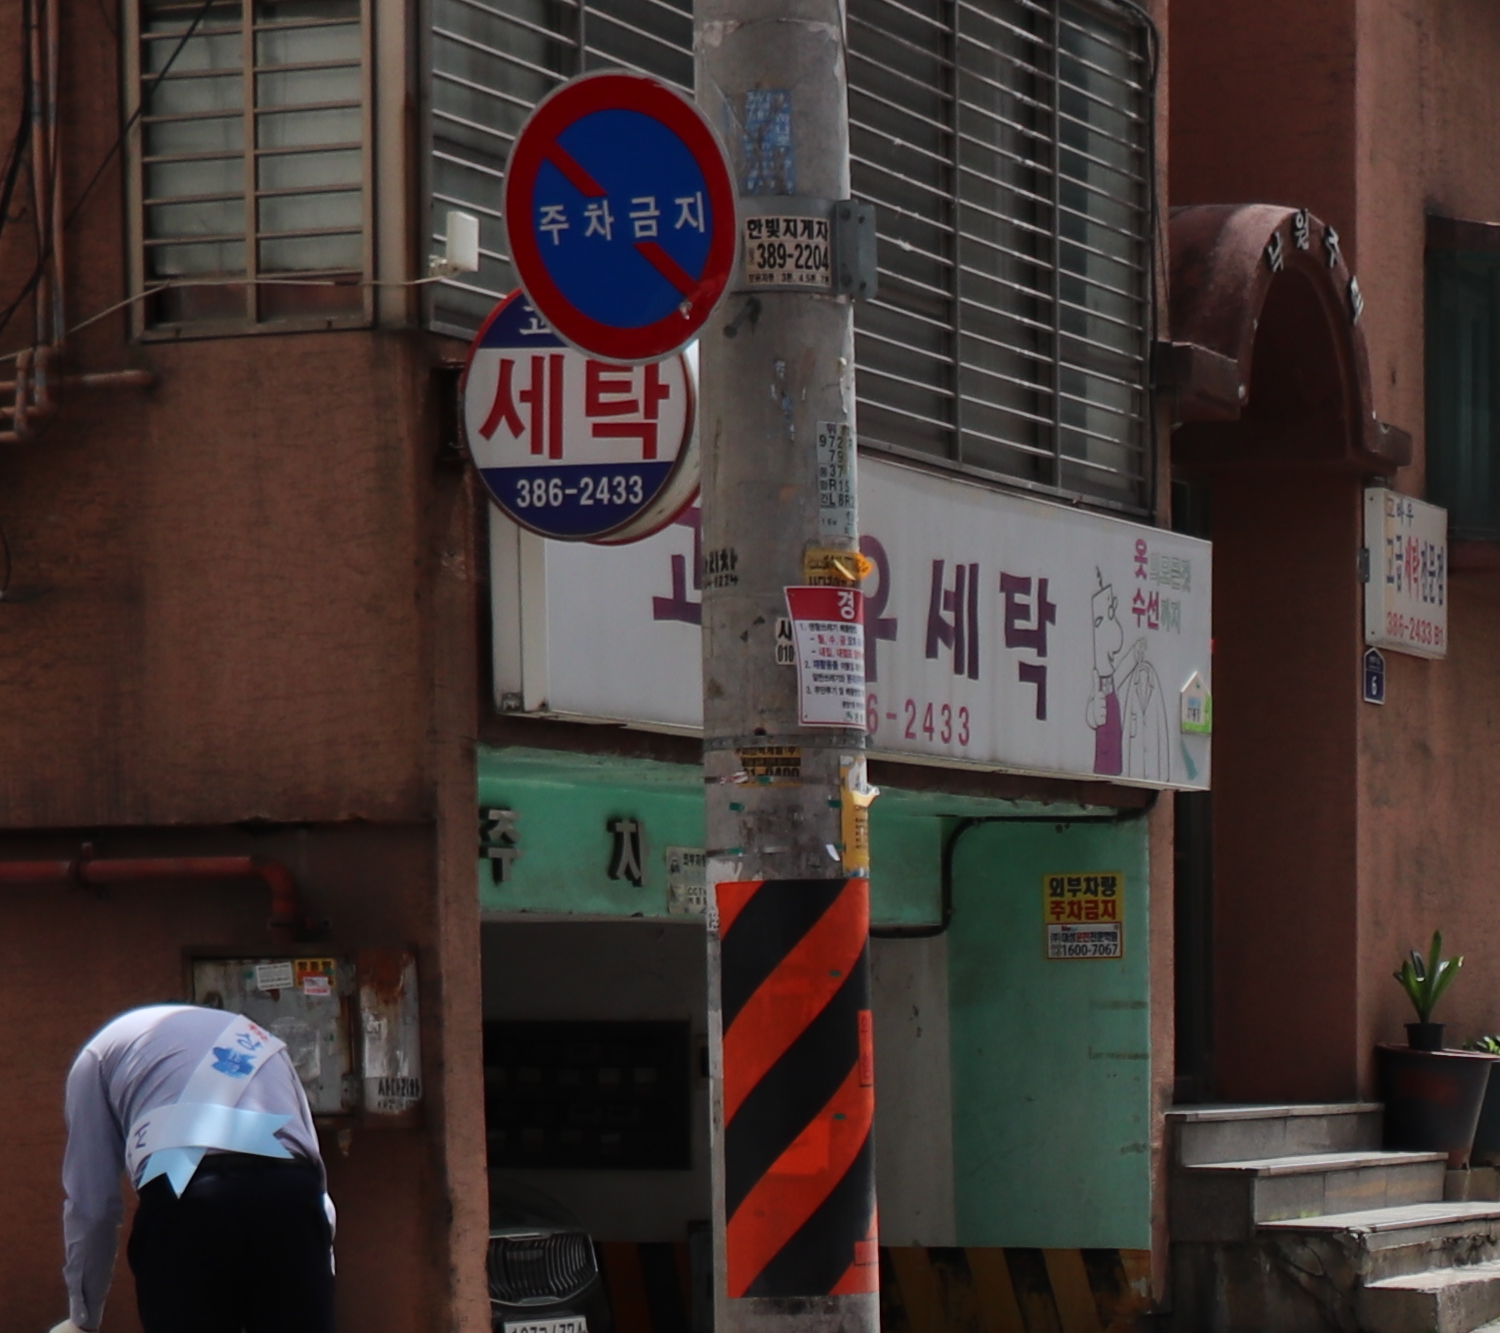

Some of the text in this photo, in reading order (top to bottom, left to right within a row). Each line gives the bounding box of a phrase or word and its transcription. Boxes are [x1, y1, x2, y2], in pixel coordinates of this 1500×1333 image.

[538, 191, 706, 246] 주차금지
[757, 243, 829, 271] 389-2204
[477, 354, 670, 460] 세탁
[516, 475, 644, 508] 386-2433
[837, 591, 855, 620] 경
[1370, 675, 1378, 697] 6
[866, 693, 971, 747] 6-2433
[1049, 876, 1117, 898] 외부차량
[1050, 899, 1116, 921] 주차금지
[1062, 943, 1118, 956] 1600-7067
